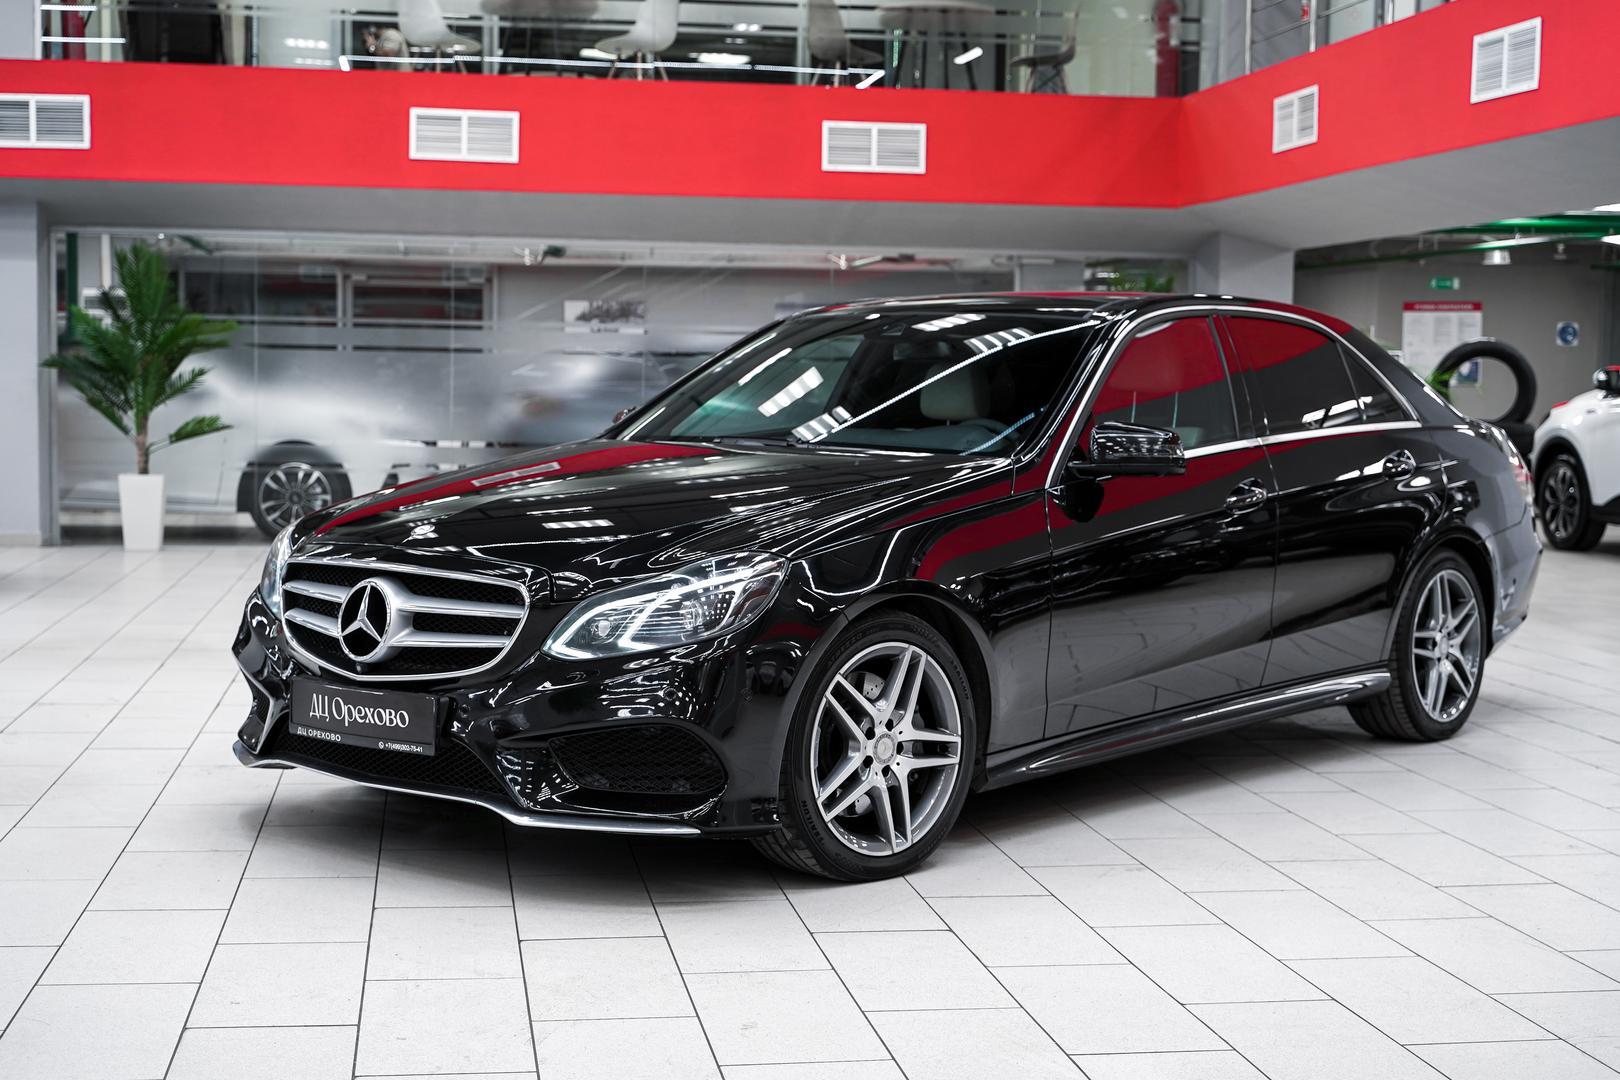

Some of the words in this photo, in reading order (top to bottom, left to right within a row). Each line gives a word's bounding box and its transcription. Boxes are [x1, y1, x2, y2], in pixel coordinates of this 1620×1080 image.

[309, 693, 330, 722] ДЦ
[332, 696, 410, 728] Орехово
[297, 726, 307, 737] ДЦ
[308, 729, 342, 742] ОРЕХОВО
